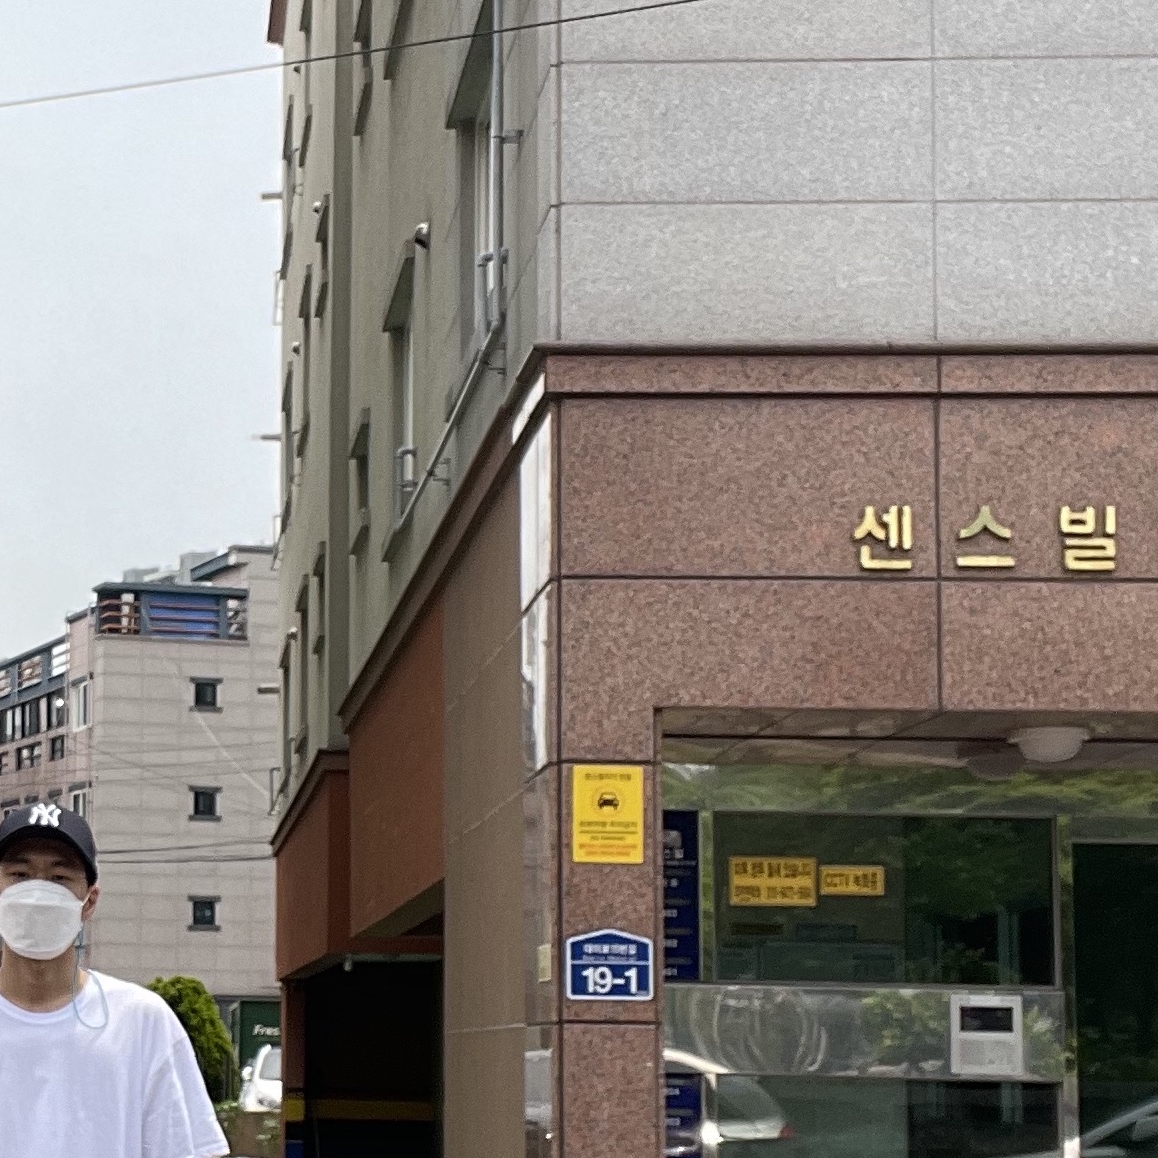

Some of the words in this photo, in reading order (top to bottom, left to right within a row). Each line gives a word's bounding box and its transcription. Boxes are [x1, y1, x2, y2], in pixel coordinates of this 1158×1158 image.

[853, 505, 1117, 571] 센스빌
[29, 803, 62, 827] NY
[582, 966, 638, 995] 19-1
